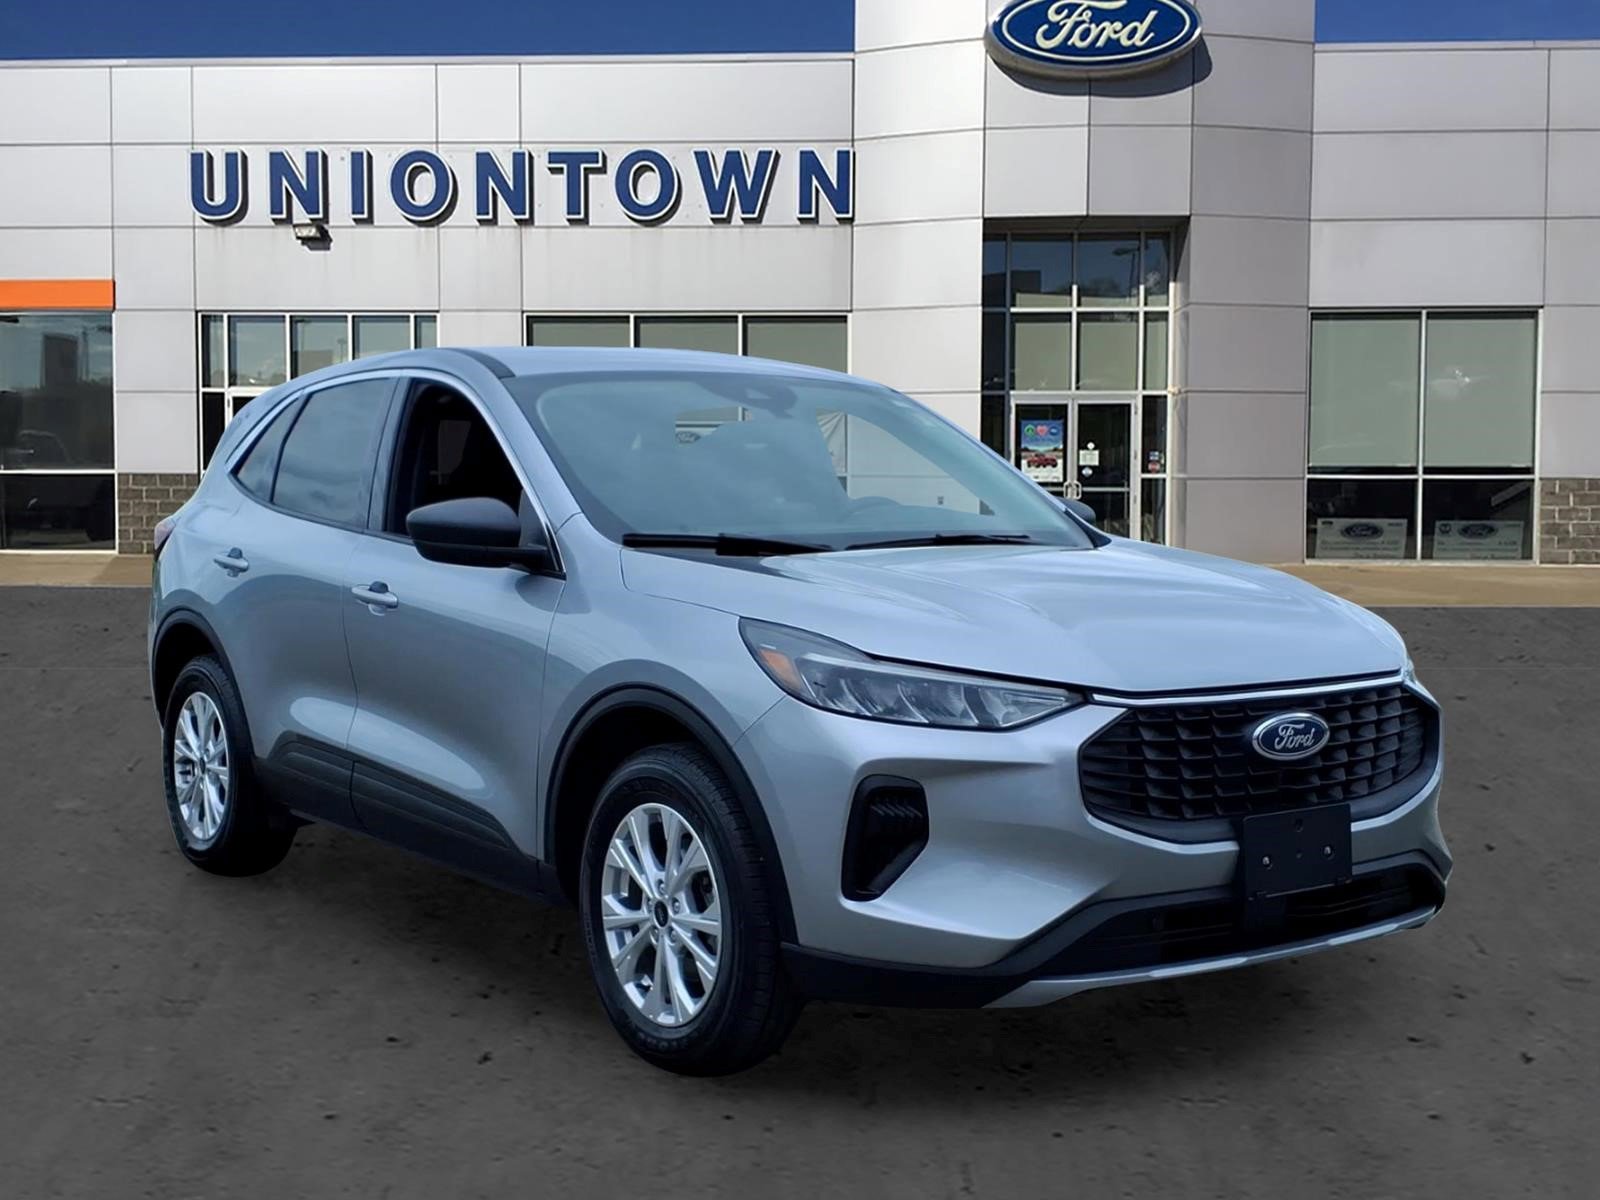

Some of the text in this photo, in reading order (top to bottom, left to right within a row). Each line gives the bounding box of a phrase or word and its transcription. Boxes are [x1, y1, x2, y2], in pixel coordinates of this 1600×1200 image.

[1035, 0, 1158, 49] Ford
[190, 149, 854, 221] UNIONTOWN
[1274, 723, 1316, 750] Ford
